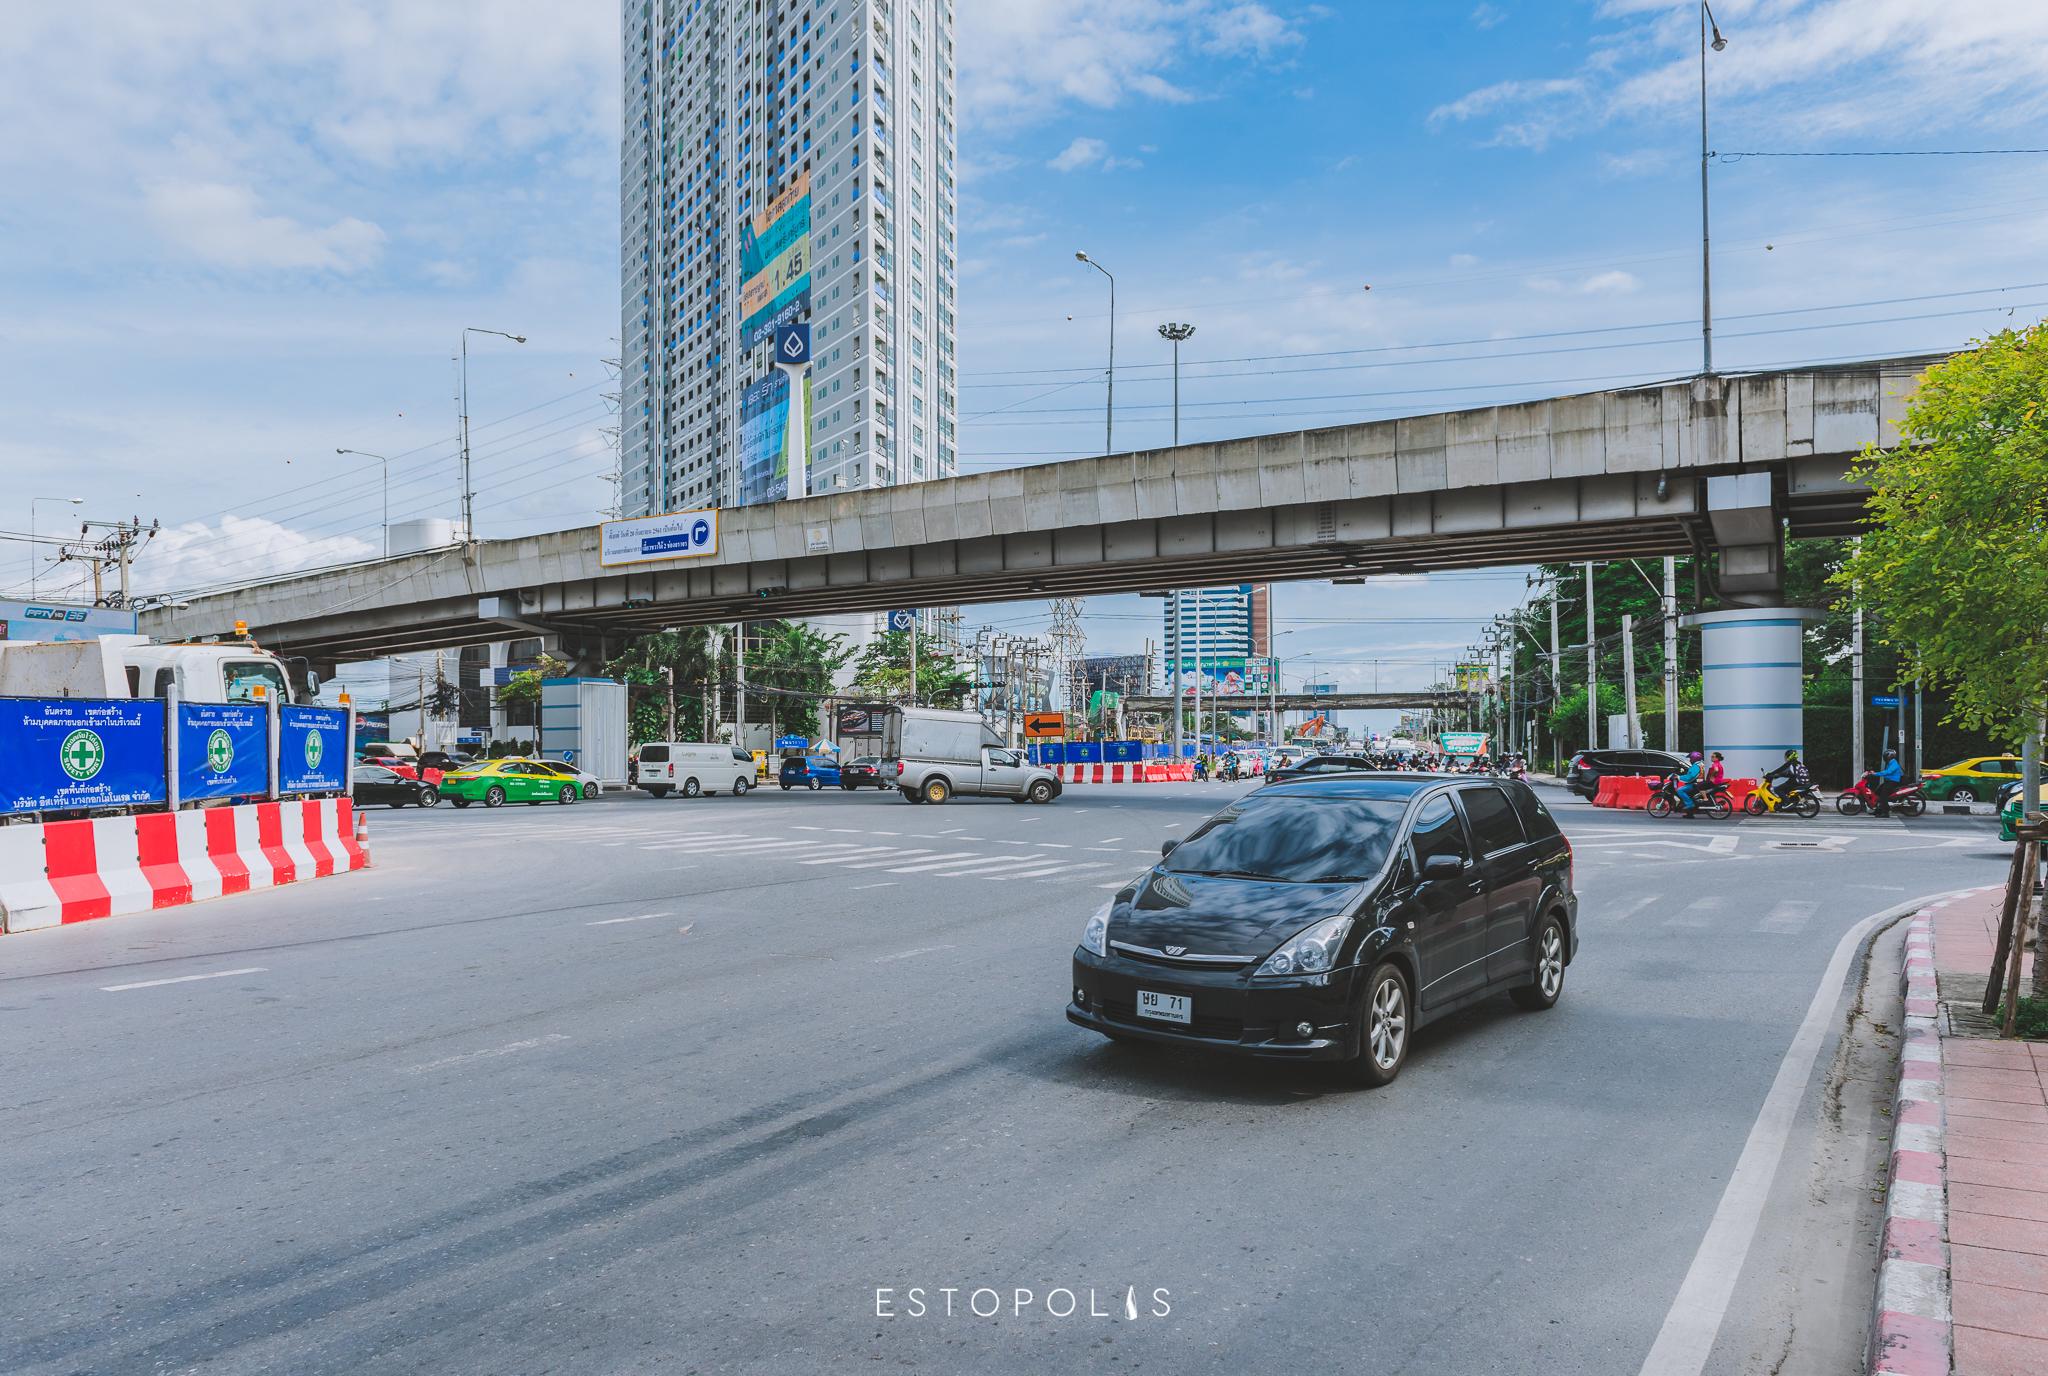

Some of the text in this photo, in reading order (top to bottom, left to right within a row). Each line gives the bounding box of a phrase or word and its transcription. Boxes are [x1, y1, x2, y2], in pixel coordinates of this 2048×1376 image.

[774, 252, 803, 291] 1.45
[44, 705, 73, 716] อันตราย
[63, 757, 101, 777] SAFETY FIRST
[13, 797, 37, 809] บริษัท
[1170, 996, 1183, 1010] 71
